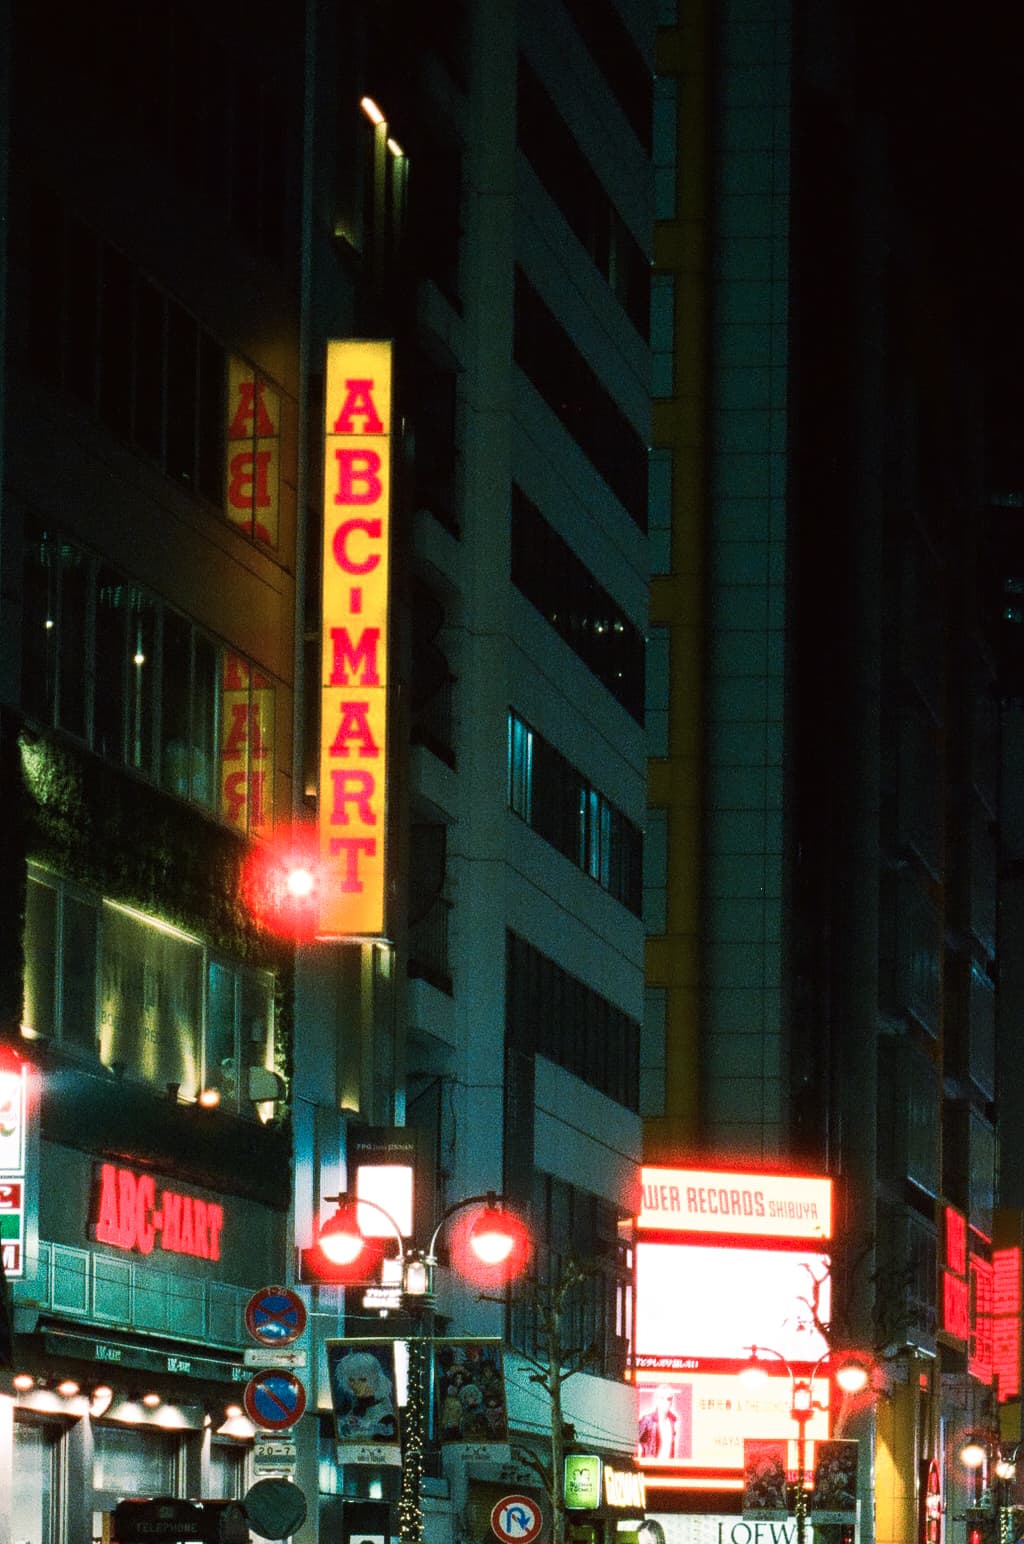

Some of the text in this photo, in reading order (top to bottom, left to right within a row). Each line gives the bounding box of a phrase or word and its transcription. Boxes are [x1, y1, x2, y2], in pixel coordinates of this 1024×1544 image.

[328, 378, 385, 893] ABC-MART
[96, 1163, 223, 1262] ABC-MART
[686, 1186, 766, 1217] RECORDS
[768, 1200, 818, 1220] SHIBUYA
[258, 1446, 291, 1456] 20-7
